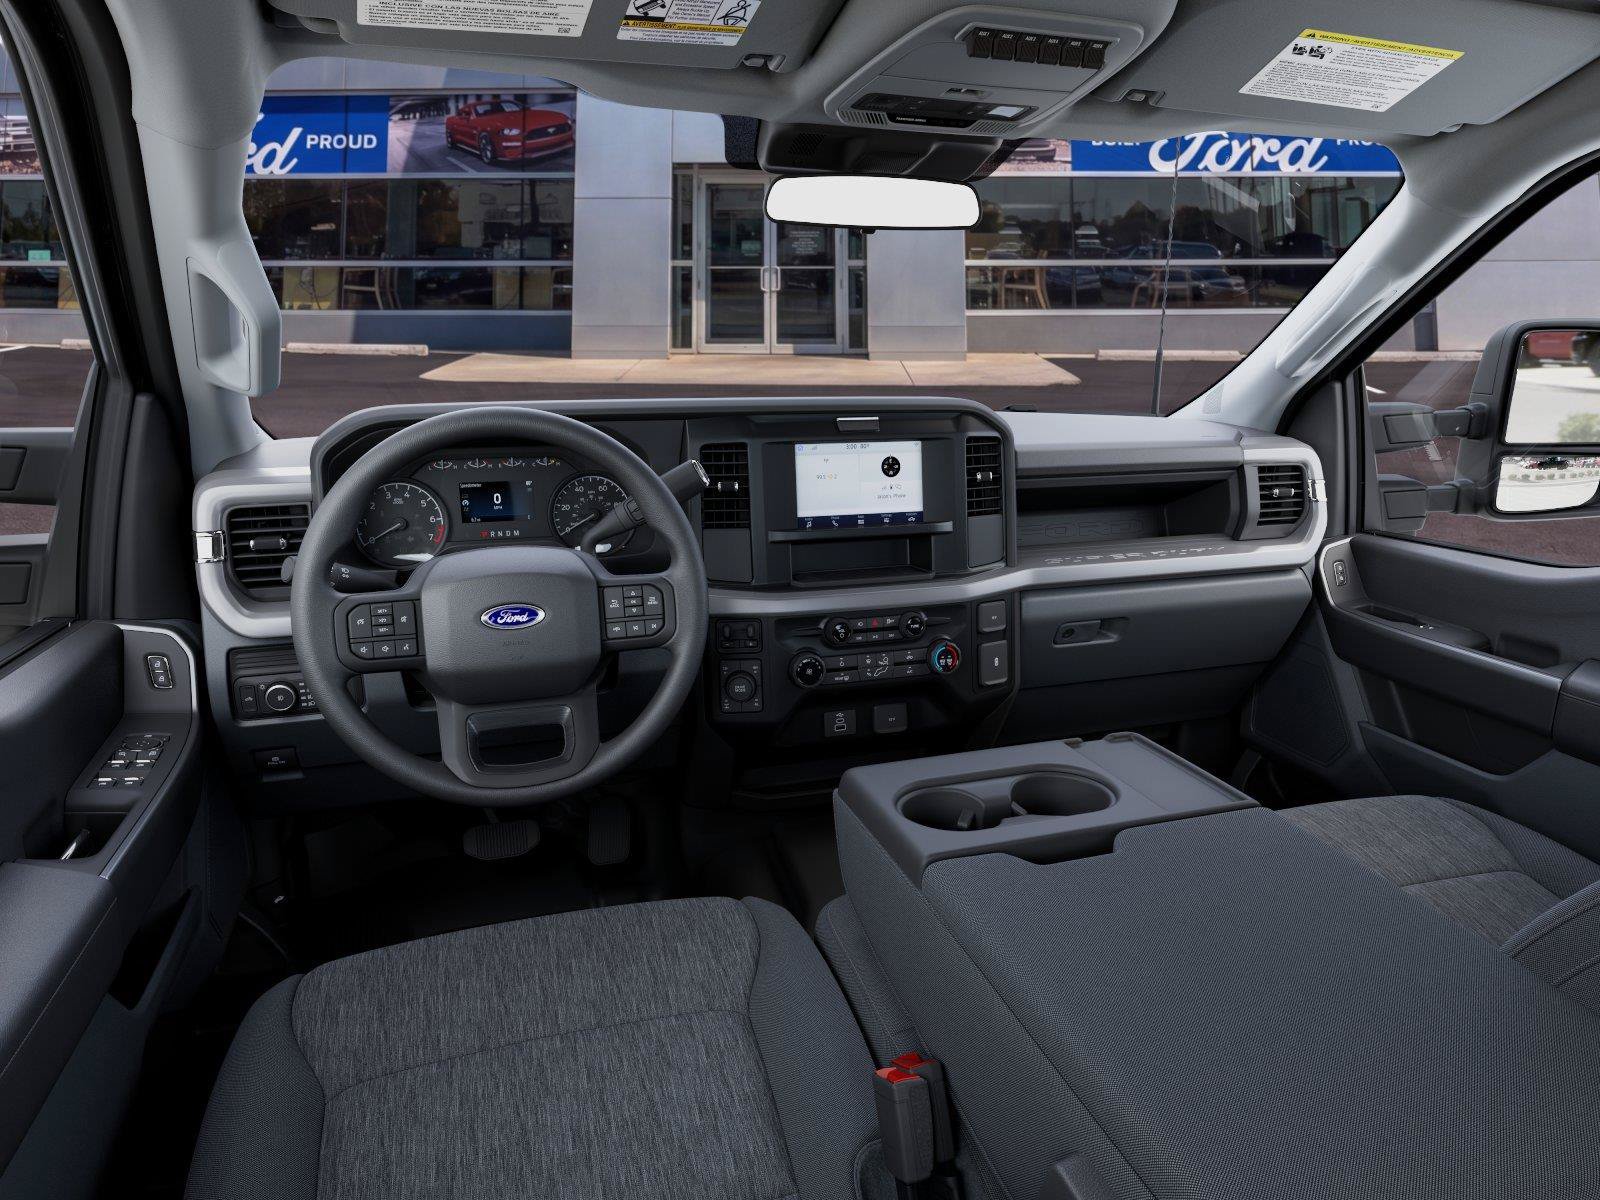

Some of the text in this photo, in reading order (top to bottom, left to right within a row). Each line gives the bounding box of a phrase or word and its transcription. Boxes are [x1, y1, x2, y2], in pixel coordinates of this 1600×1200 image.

[632, 21, 677, 29] AVERTISSEMENT
[306, 134, 377, 149] PROUD
[1149, 131, 1328, 172] Ford
[384, 491, 391, 499] 3
[403, 491, 410, 499] 4
[493, 493, 502, 504] 0
[369, 502, 376, 510] 2
[429, 515, 436, 523] 6
[368, 536, 375, 544] 0
[428, 533, 434, 541] 7
[497, 609, 529, 624] Ford
